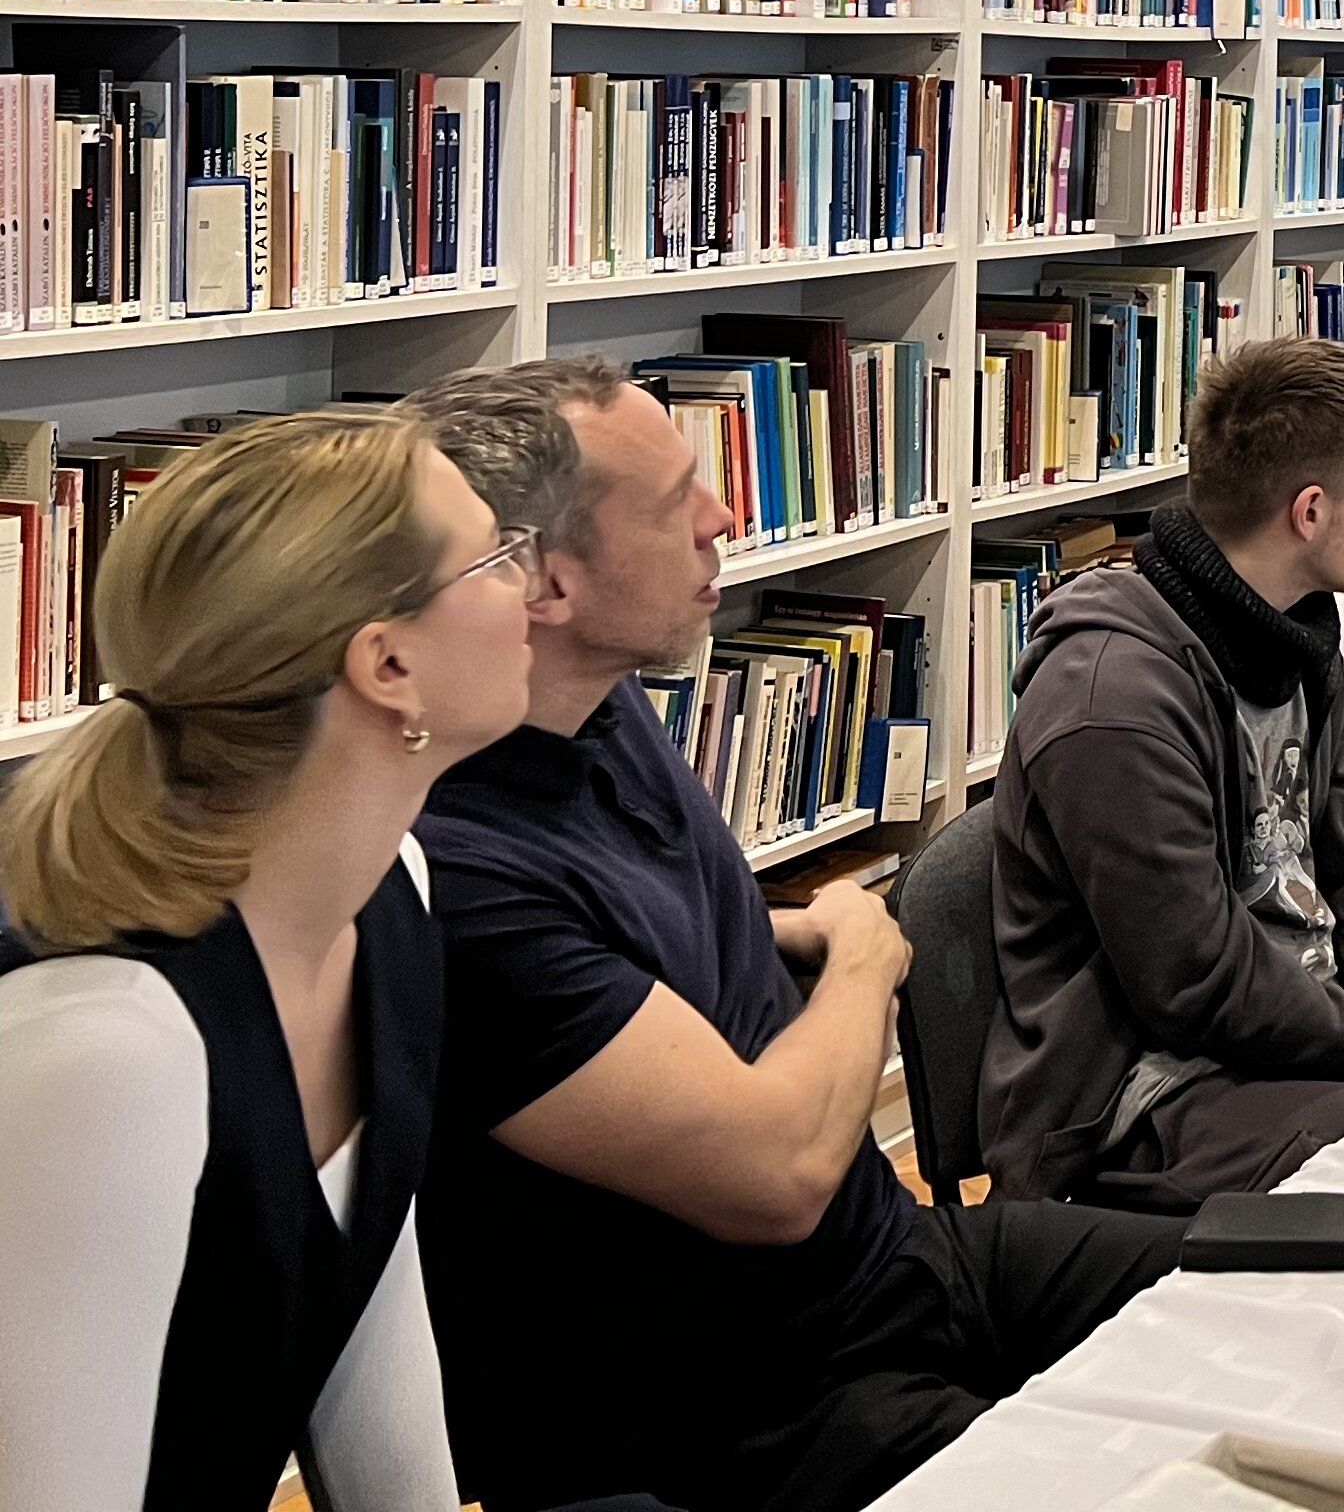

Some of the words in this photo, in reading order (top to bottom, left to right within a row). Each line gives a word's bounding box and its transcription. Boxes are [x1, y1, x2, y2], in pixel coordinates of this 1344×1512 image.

[254, 131, 268, 276] STATISZTIKA
[42, 236, 50, 274] KATALIN
[108, 469, 120, 508] VIKTOR
